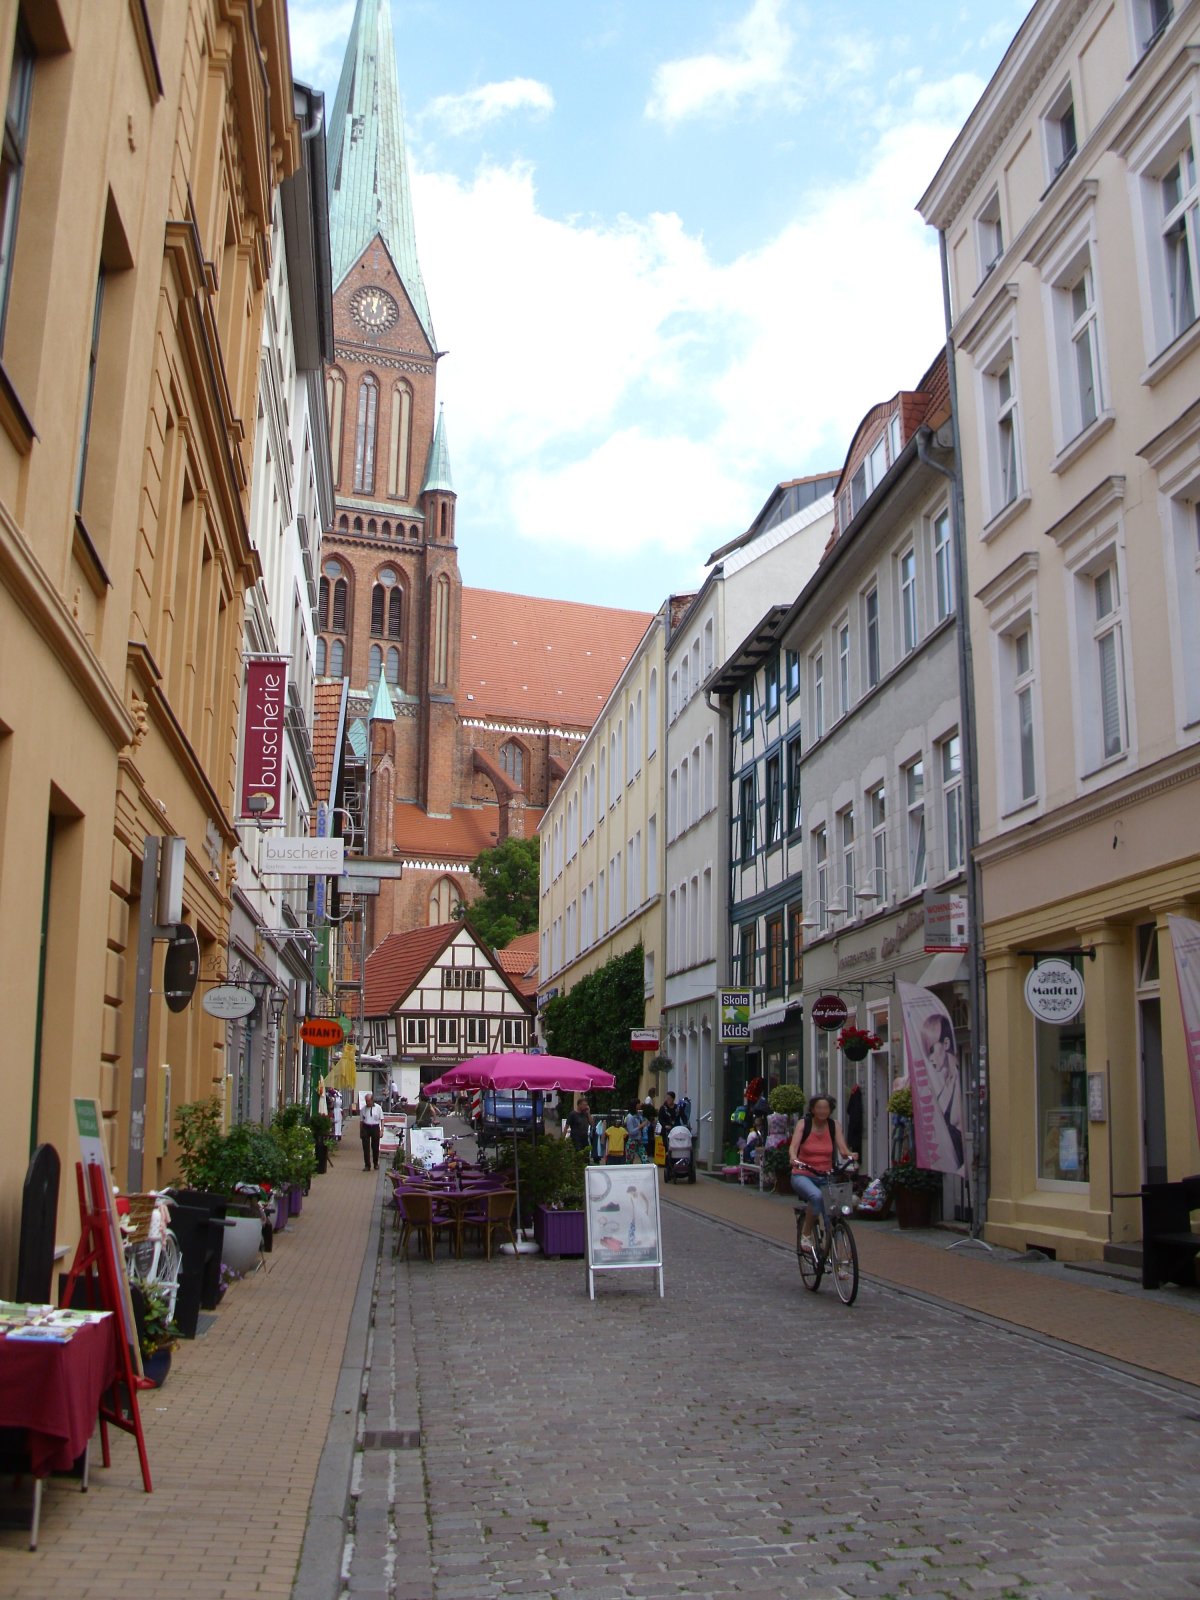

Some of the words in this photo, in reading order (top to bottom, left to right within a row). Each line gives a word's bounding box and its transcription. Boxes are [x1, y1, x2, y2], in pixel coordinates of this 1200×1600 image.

[248, 673, 280, 787] buschérie
[266, 841, 338, 859] buschérie
[723, 995, 748, 1005] Skole
[302, 1027, 341, 1038] SHANTI
[723, 1024, 748, 1036] Kids
